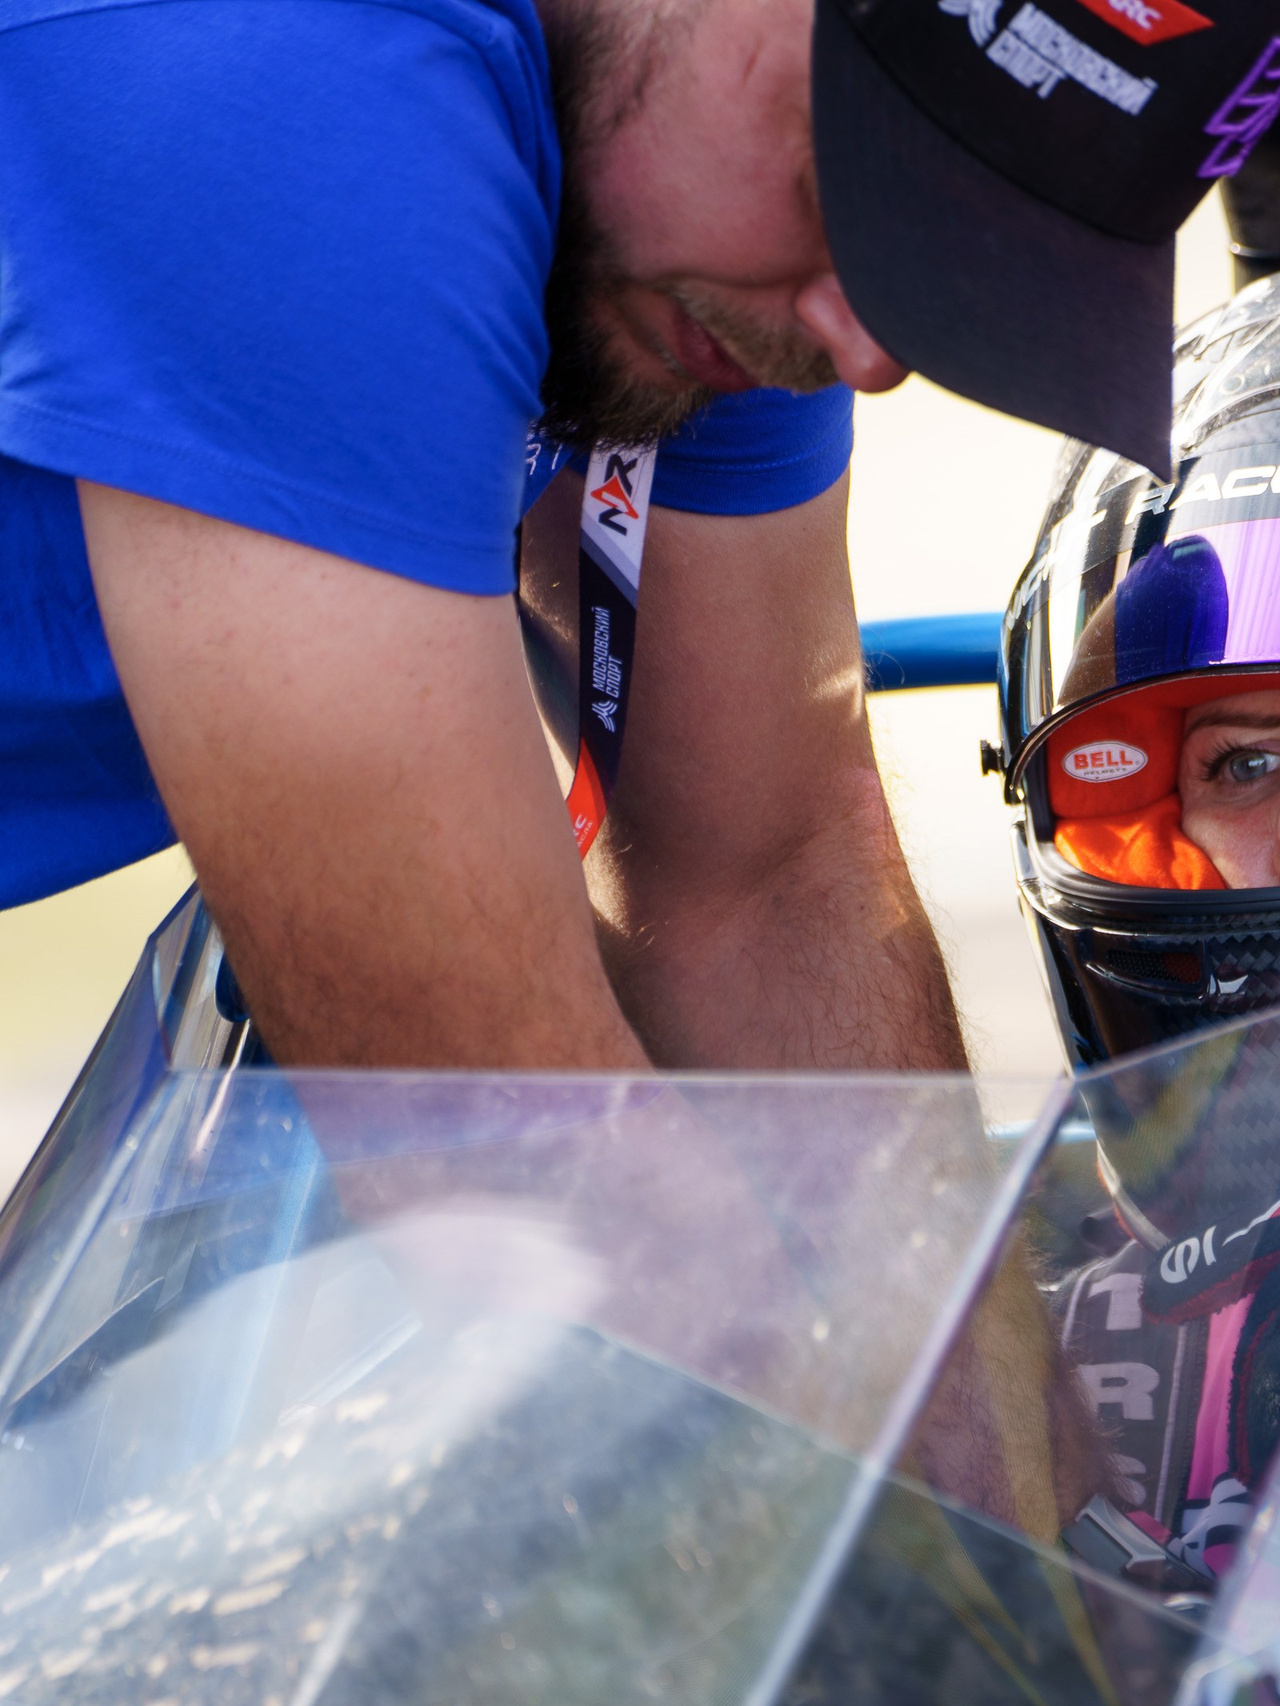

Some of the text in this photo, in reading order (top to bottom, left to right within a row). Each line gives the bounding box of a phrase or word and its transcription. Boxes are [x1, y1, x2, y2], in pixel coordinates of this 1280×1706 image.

[591, 605, 611, 692] МОСКОВСКИЙ
[605, 655, 622, 698] СПОРТ
[1074, 750, 1133, 770] BELL
